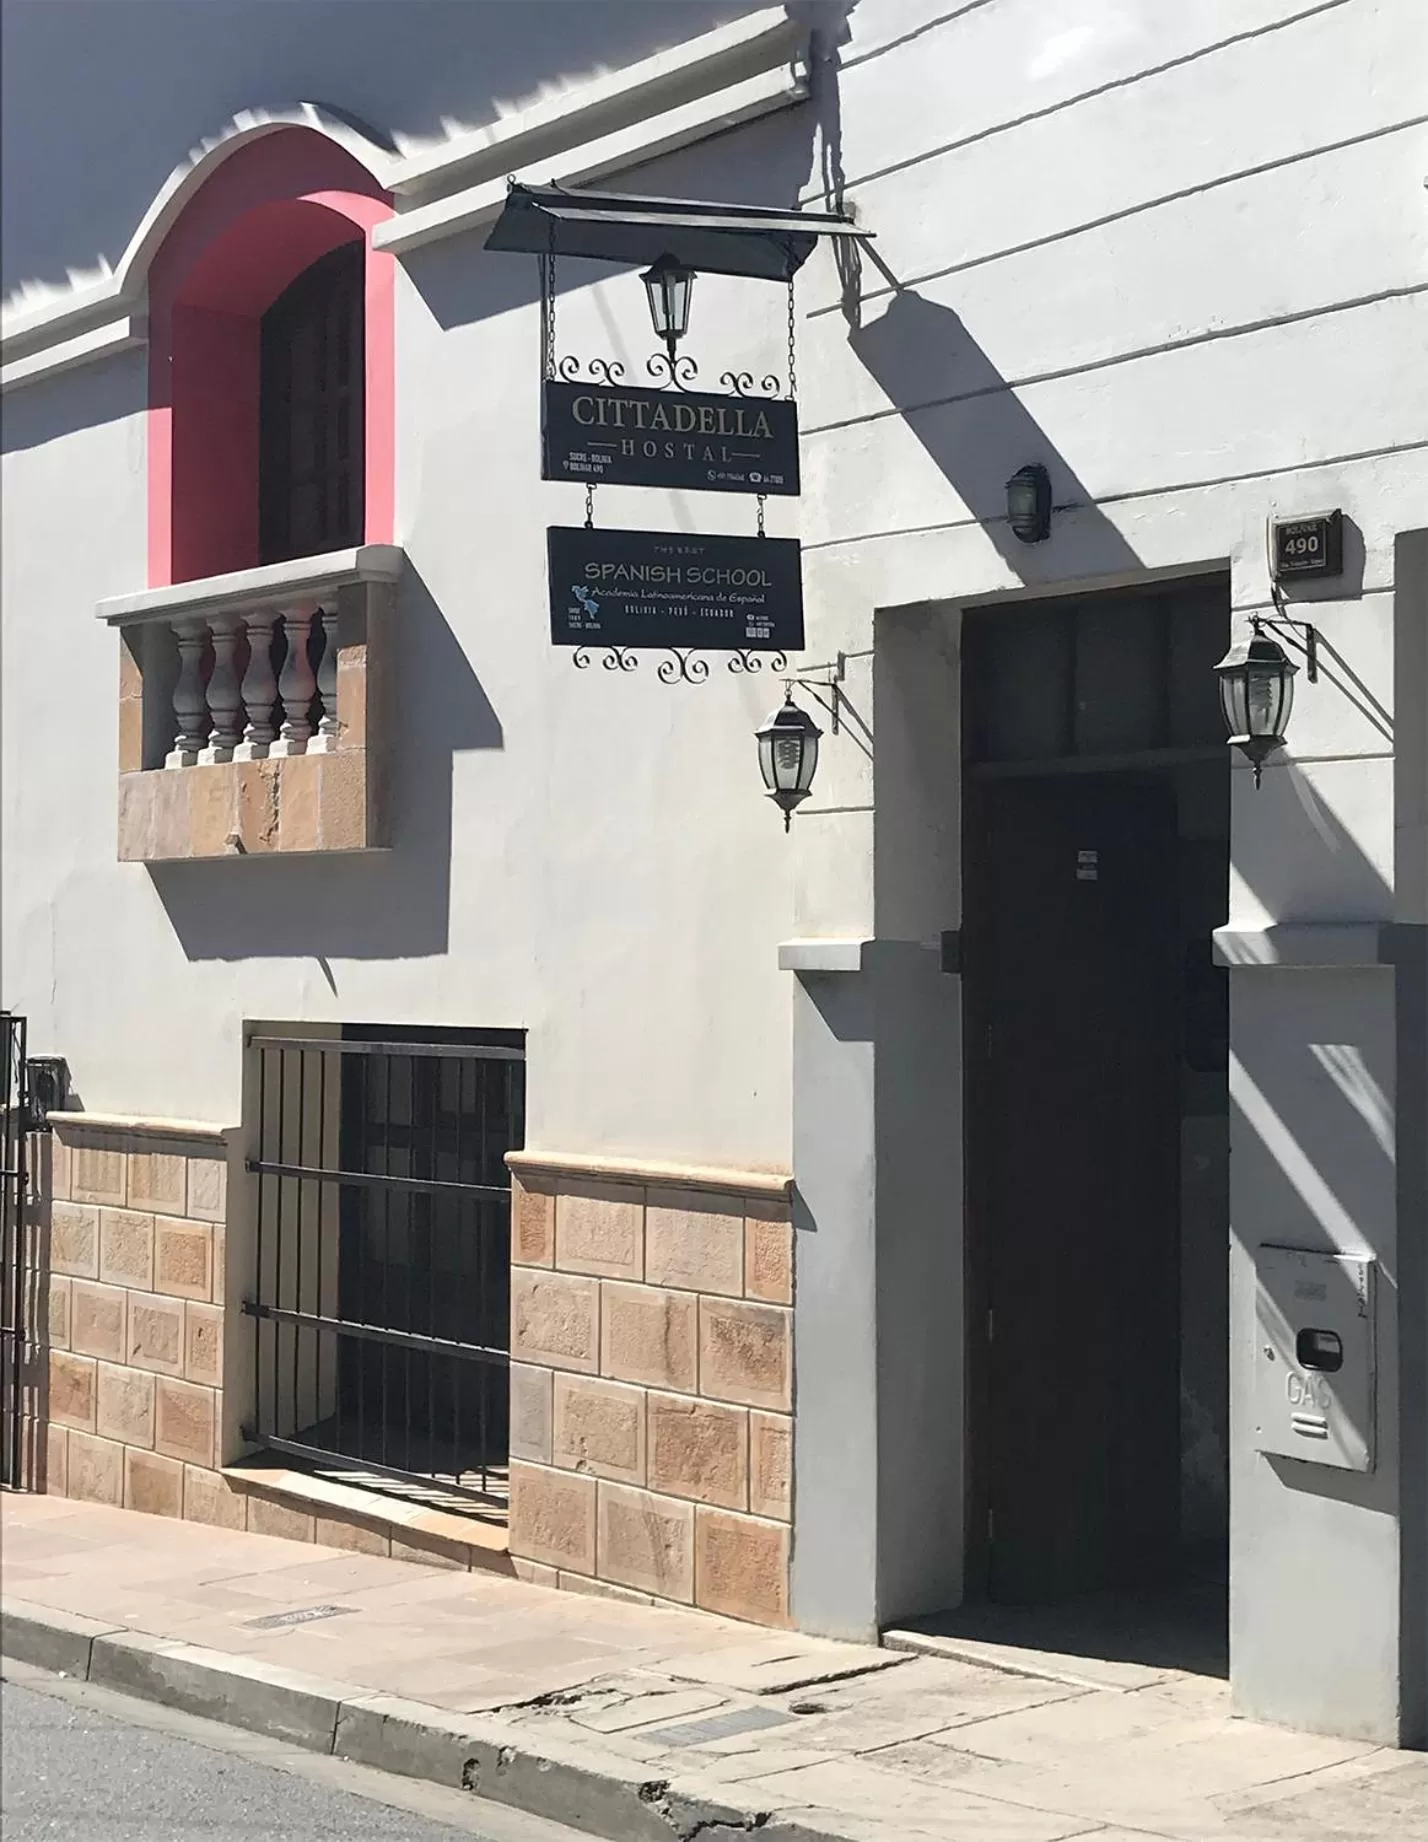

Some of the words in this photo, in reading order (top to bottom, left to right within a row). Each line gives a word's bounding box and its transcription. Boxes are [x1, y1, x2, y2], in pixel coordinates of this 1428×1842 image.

[572, 397, 774, 438] CITTADELLA
[622, 439, 733, 463] HOSTAL
[1285, 536, 1318, 554] 490
[585, 562, 681, 584] SPANISH
[687, 567, 772, 586] SCHOOL
[591, 586, 639, 598] Academia
[641, 589, 714, 601] Latinoamericana
[716, 592, 727, 602] de
[729, 593, 765, 604] Español
[625, 604, 657, 615] BOLIVIA
[701, 607, 734, 618] ECUADOR
[1286, 1371, 1332, 1409] GAS
